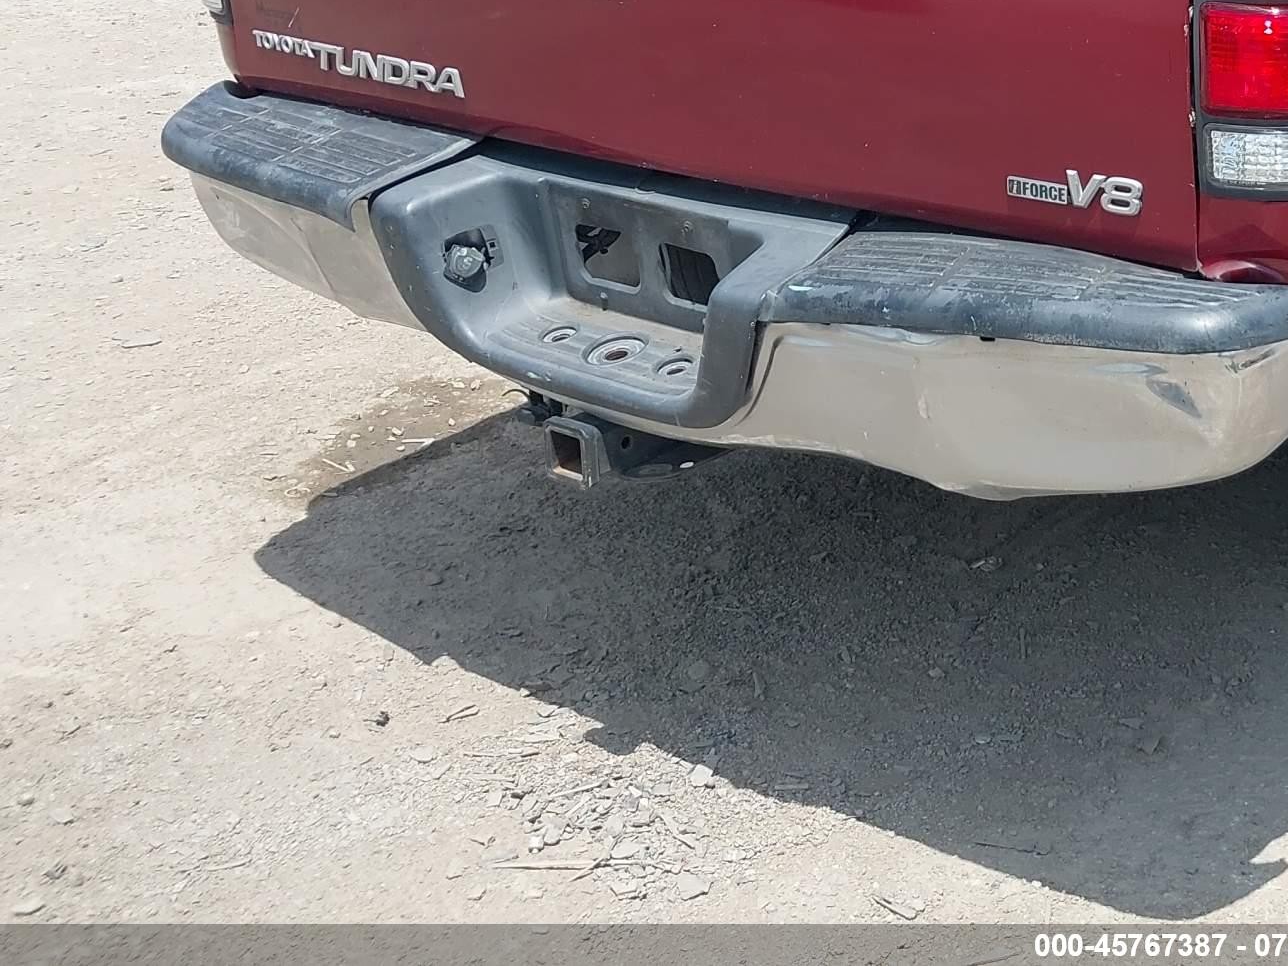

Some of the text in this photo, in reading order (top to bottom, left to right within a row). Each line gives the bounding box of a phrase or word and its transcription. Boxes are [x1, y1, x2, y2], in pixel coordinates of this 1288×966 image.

[252, 29, 465, 98] TOYOTA TUNDRA
[1065, 169, 1143, 216] V8
